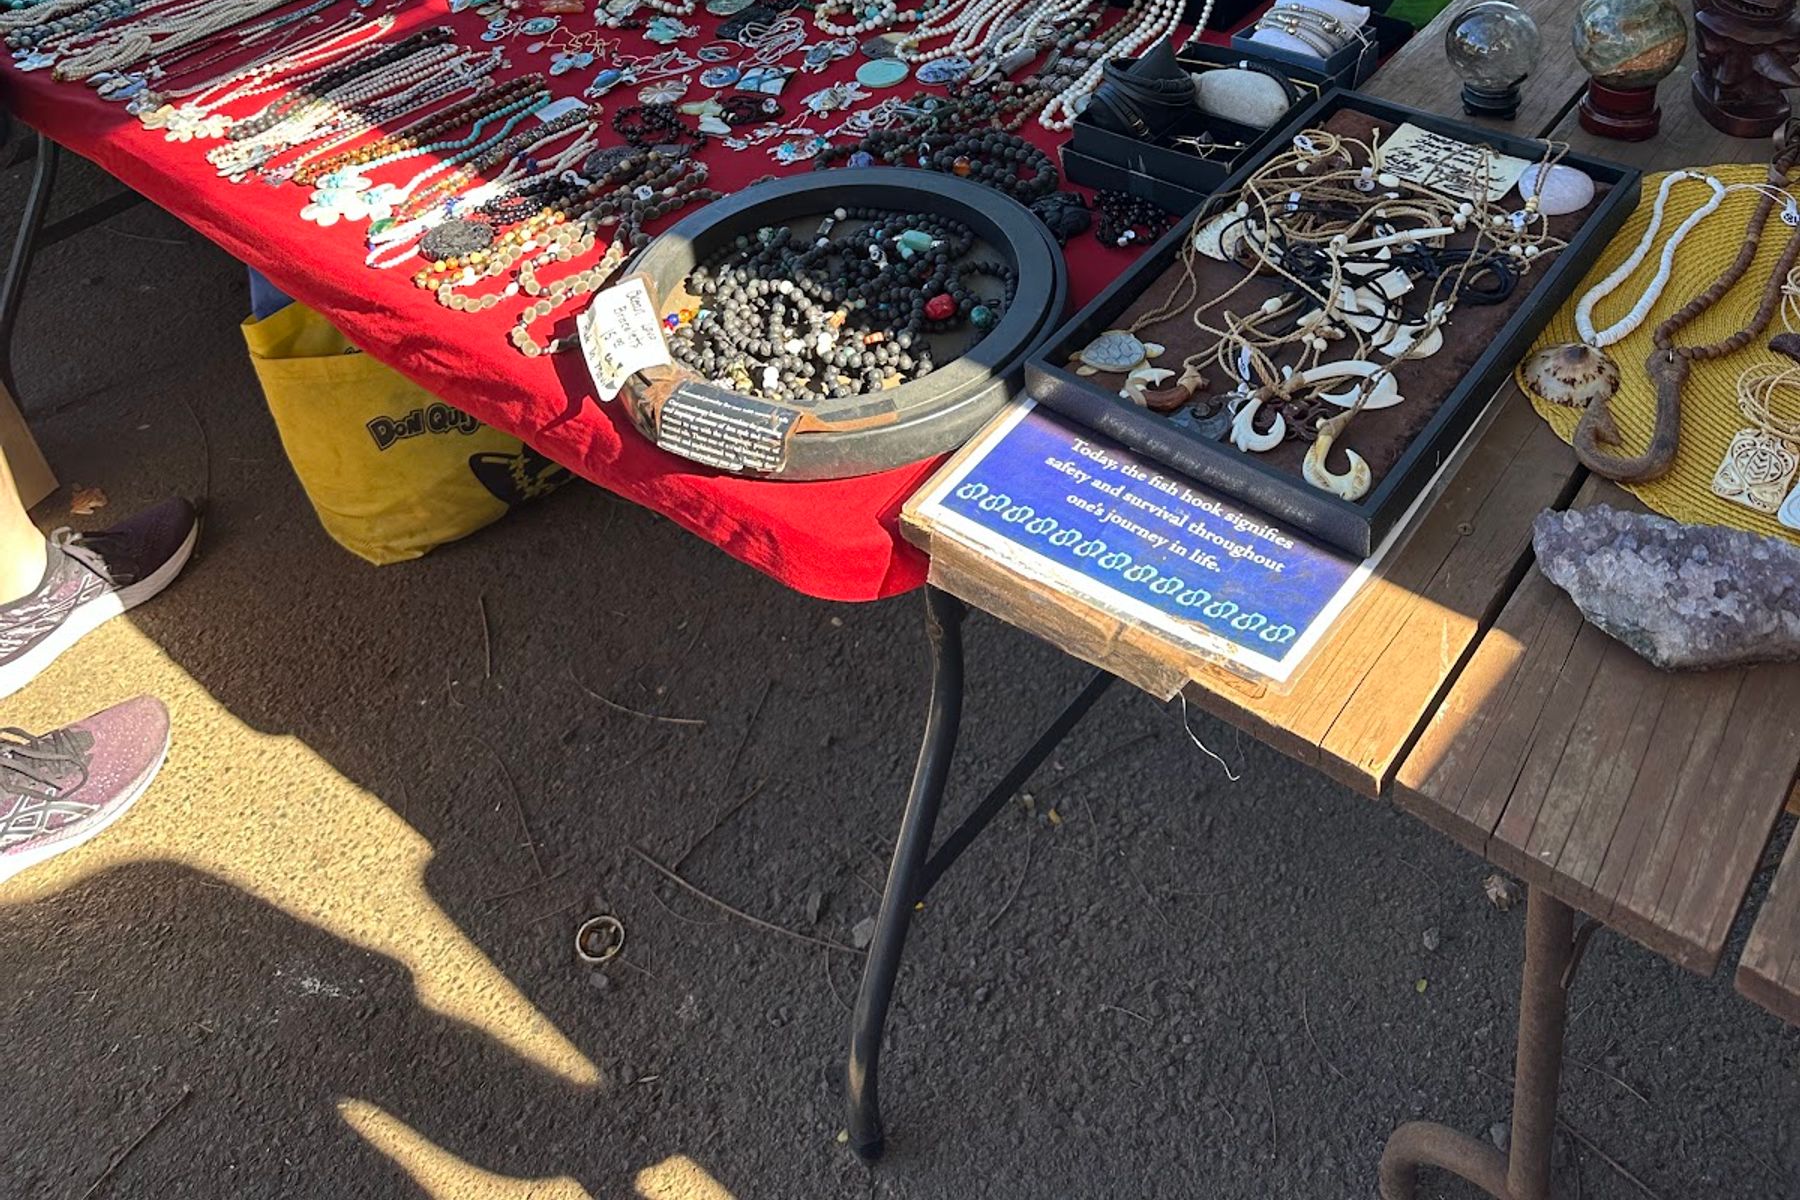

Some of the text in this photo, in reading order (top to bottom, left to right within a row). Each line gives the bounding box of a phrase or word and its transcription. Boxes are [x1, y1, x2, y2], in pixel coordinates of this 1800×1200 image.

[1045, 455, 1285, 573] safety and survival throughout
[1066, 493, 1222, 573] one's journey in life.
[1071, 438, 1295, 550] Today, the fish hook signifies
